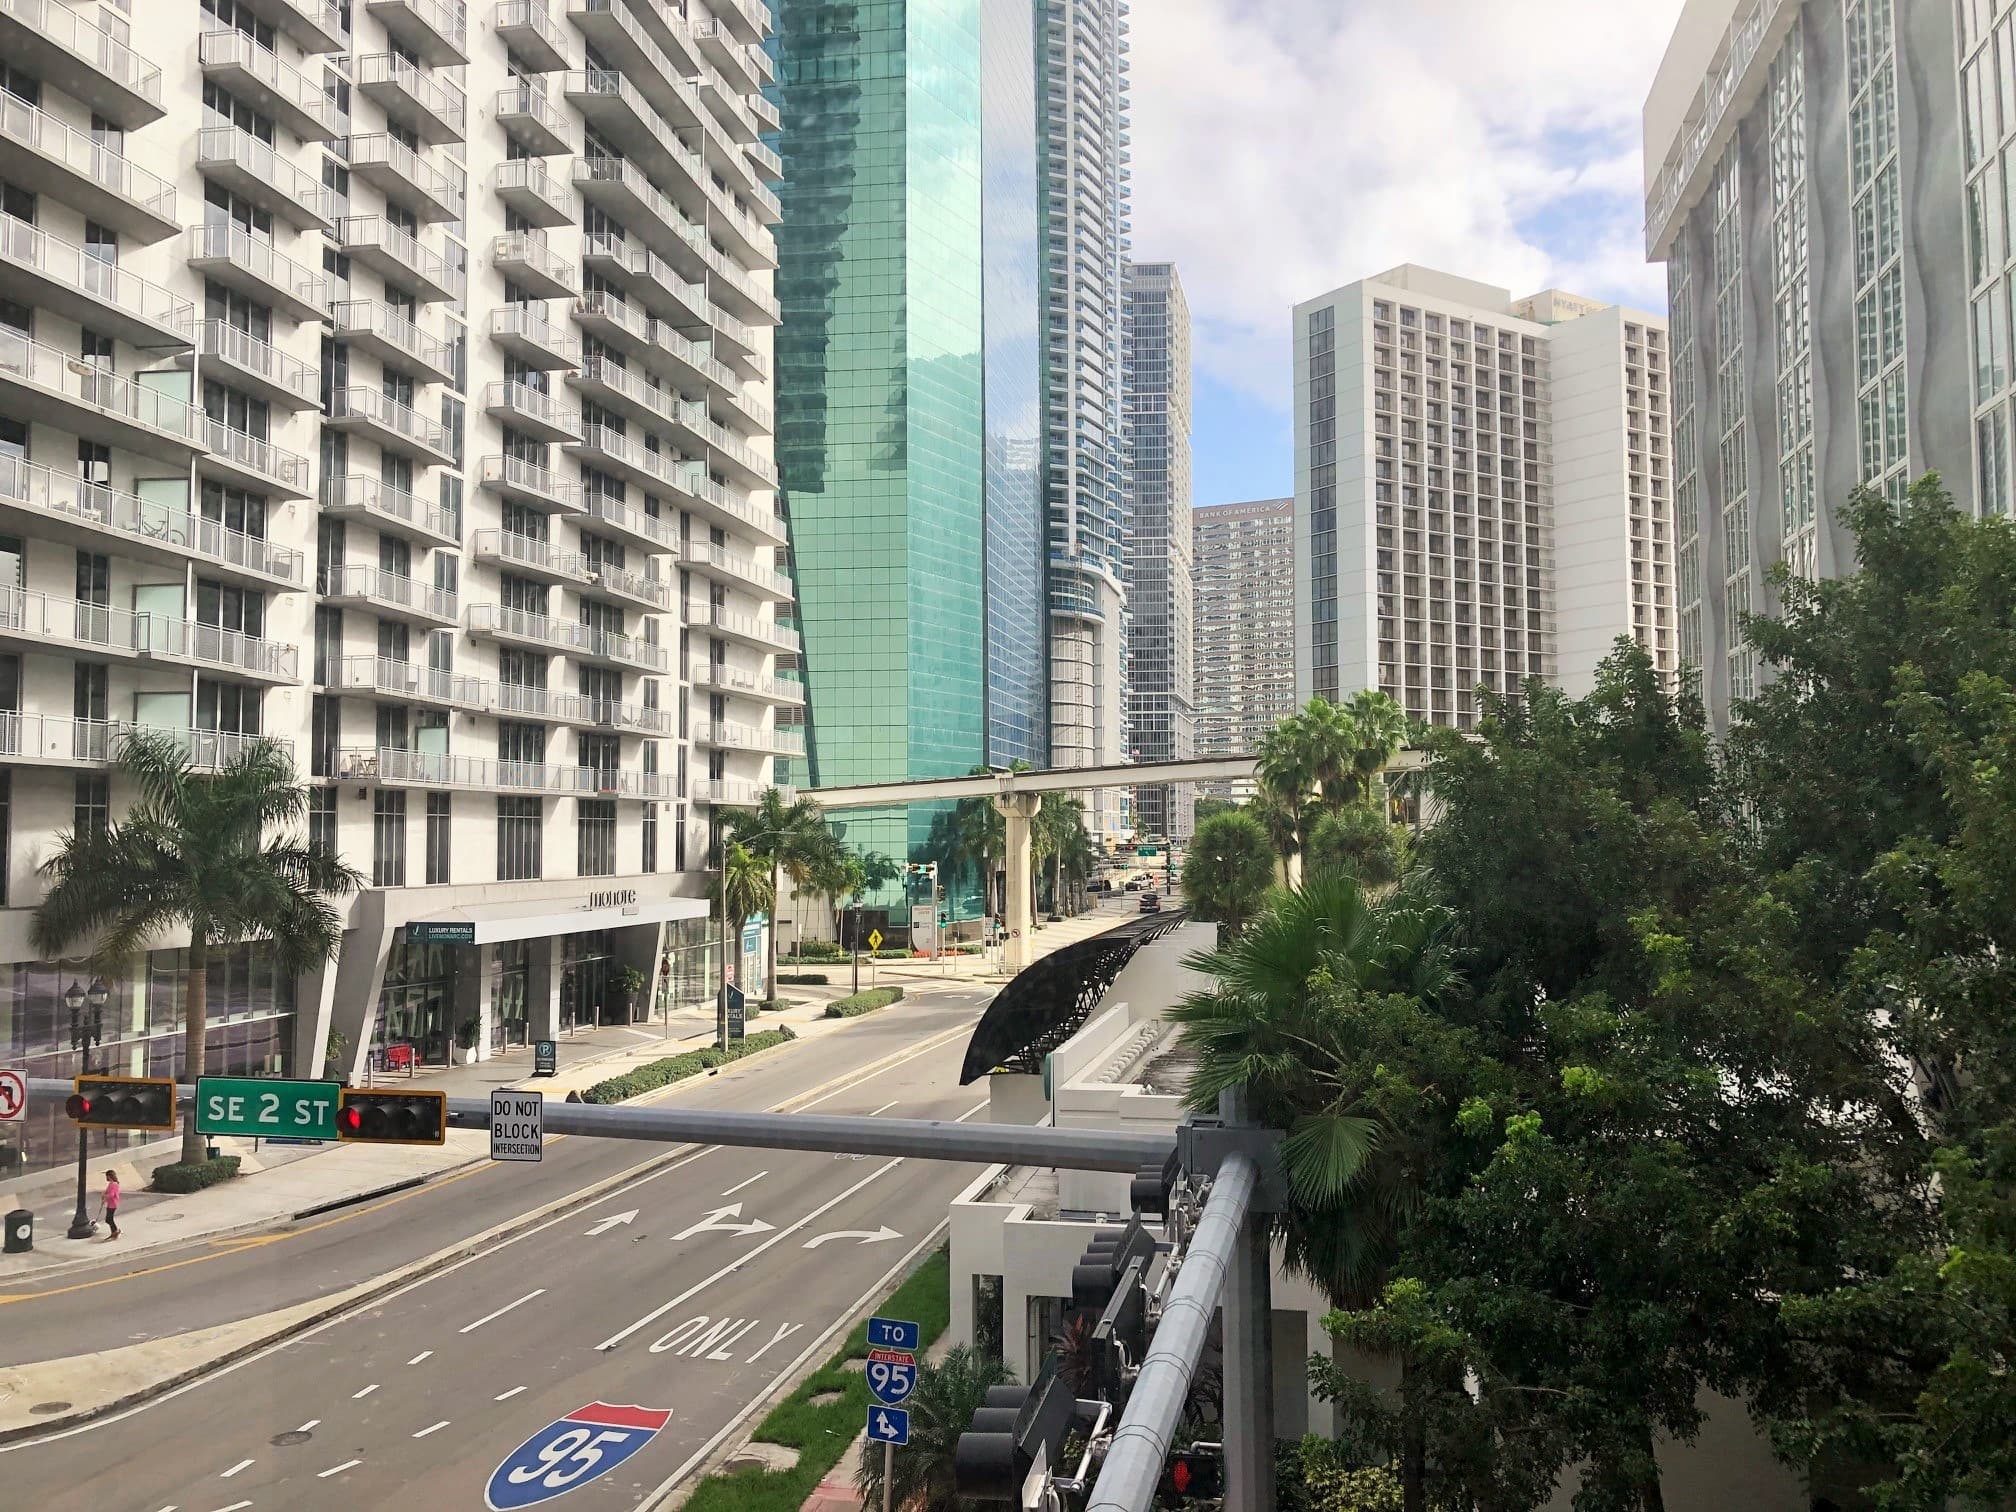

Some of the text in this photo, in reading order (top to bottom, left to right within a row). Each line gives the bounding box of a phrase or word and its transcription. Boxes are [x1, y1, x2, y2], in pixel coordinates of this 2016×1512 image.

[1199, 505, 1271, 519] BANK OF AMERICA
[207, 1093, 330, 1126] SE 2 ST
[494, 1100, 539, 1117] DO NOT
[494, 1122, 539, 1139] BLOCK
[493, 1142, 540, 1155] INTERSECTION
[649, 1316, 804, 1364] ONLY
[881, 1324, 905, 1342] TO
[874, 1352, 910, 1363] INTERSTATE
[871, 1363, 910, 1395] 95
[507, 1428, 632, 1488] 95
